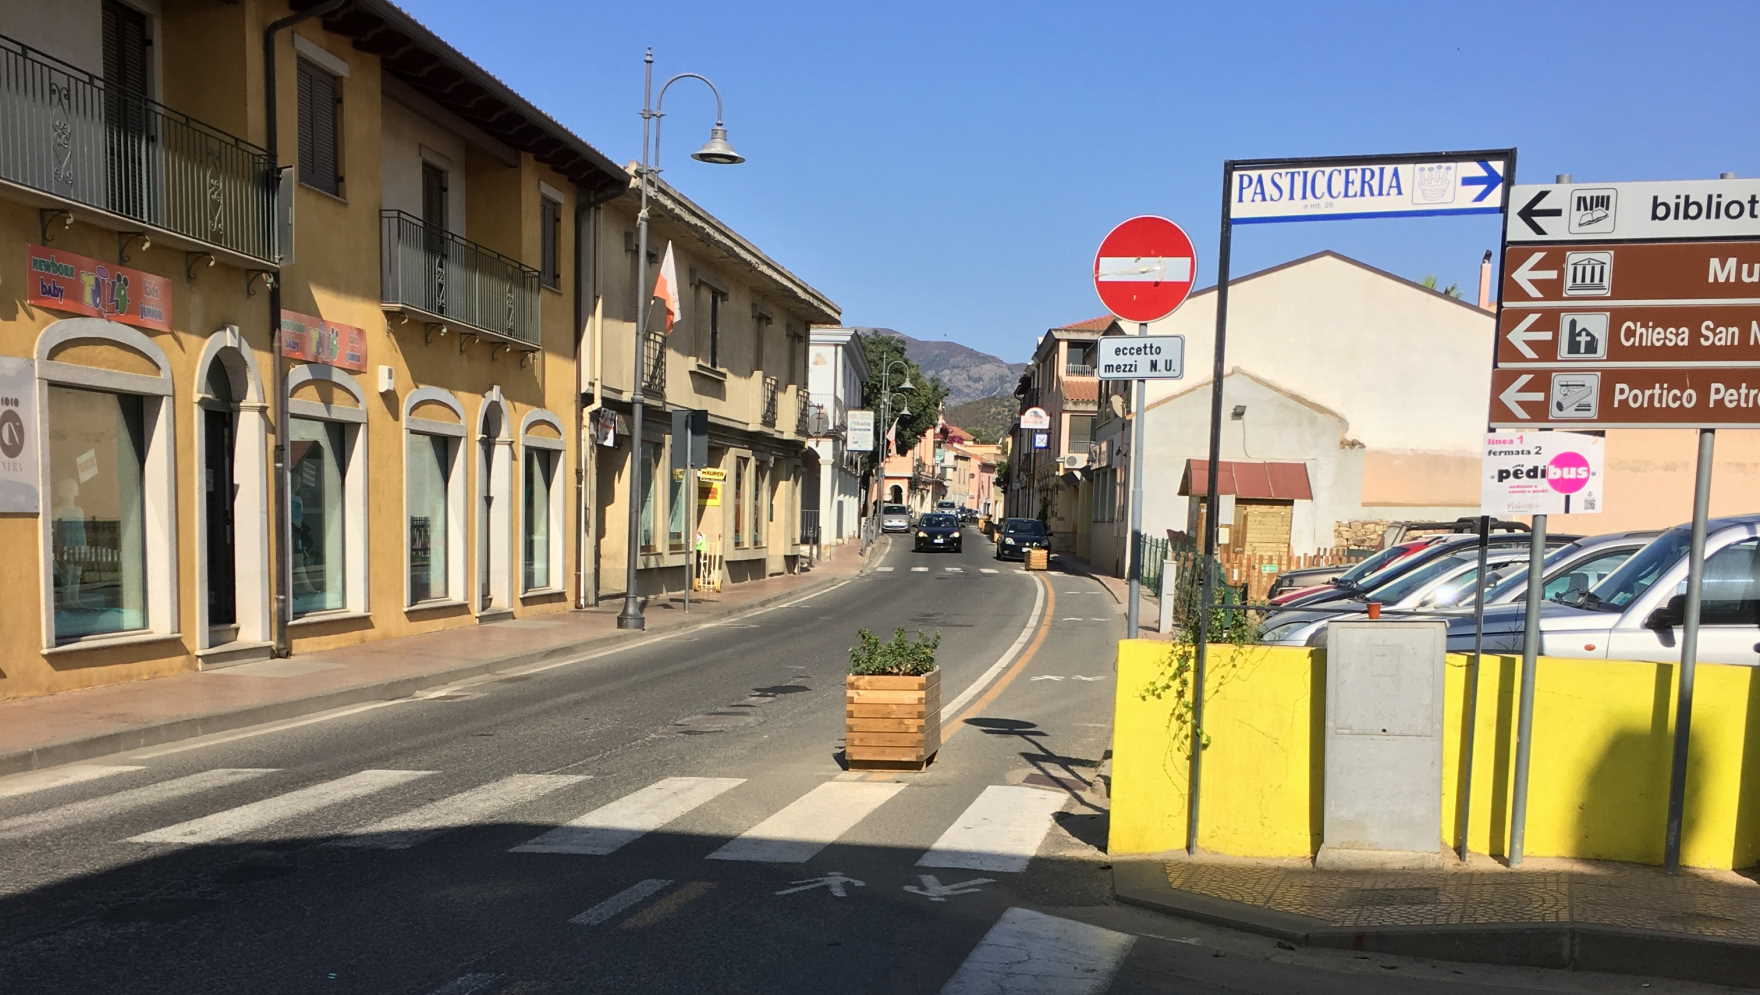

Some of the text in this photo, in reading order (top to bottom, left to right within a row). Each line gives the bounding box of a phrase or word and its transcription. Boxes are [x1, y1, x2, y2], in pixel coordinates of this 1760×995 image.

[1237, 166, 1404, 203] PASTICCERIA
[1651, 194, 1759, 221] bibliot
[1708, 257, 1760, 283] Mu
[1620, 321, 1689, 347] Chiesa
[1700, 320, 1739, 346] San
[1114, 343, 1162, 357] eccetto
[1104, 360, 1138, 374] mezzi
[1613, 383, 1760, 408] Portico Petr
[1487, 446, 1542, 457] fermata 2
